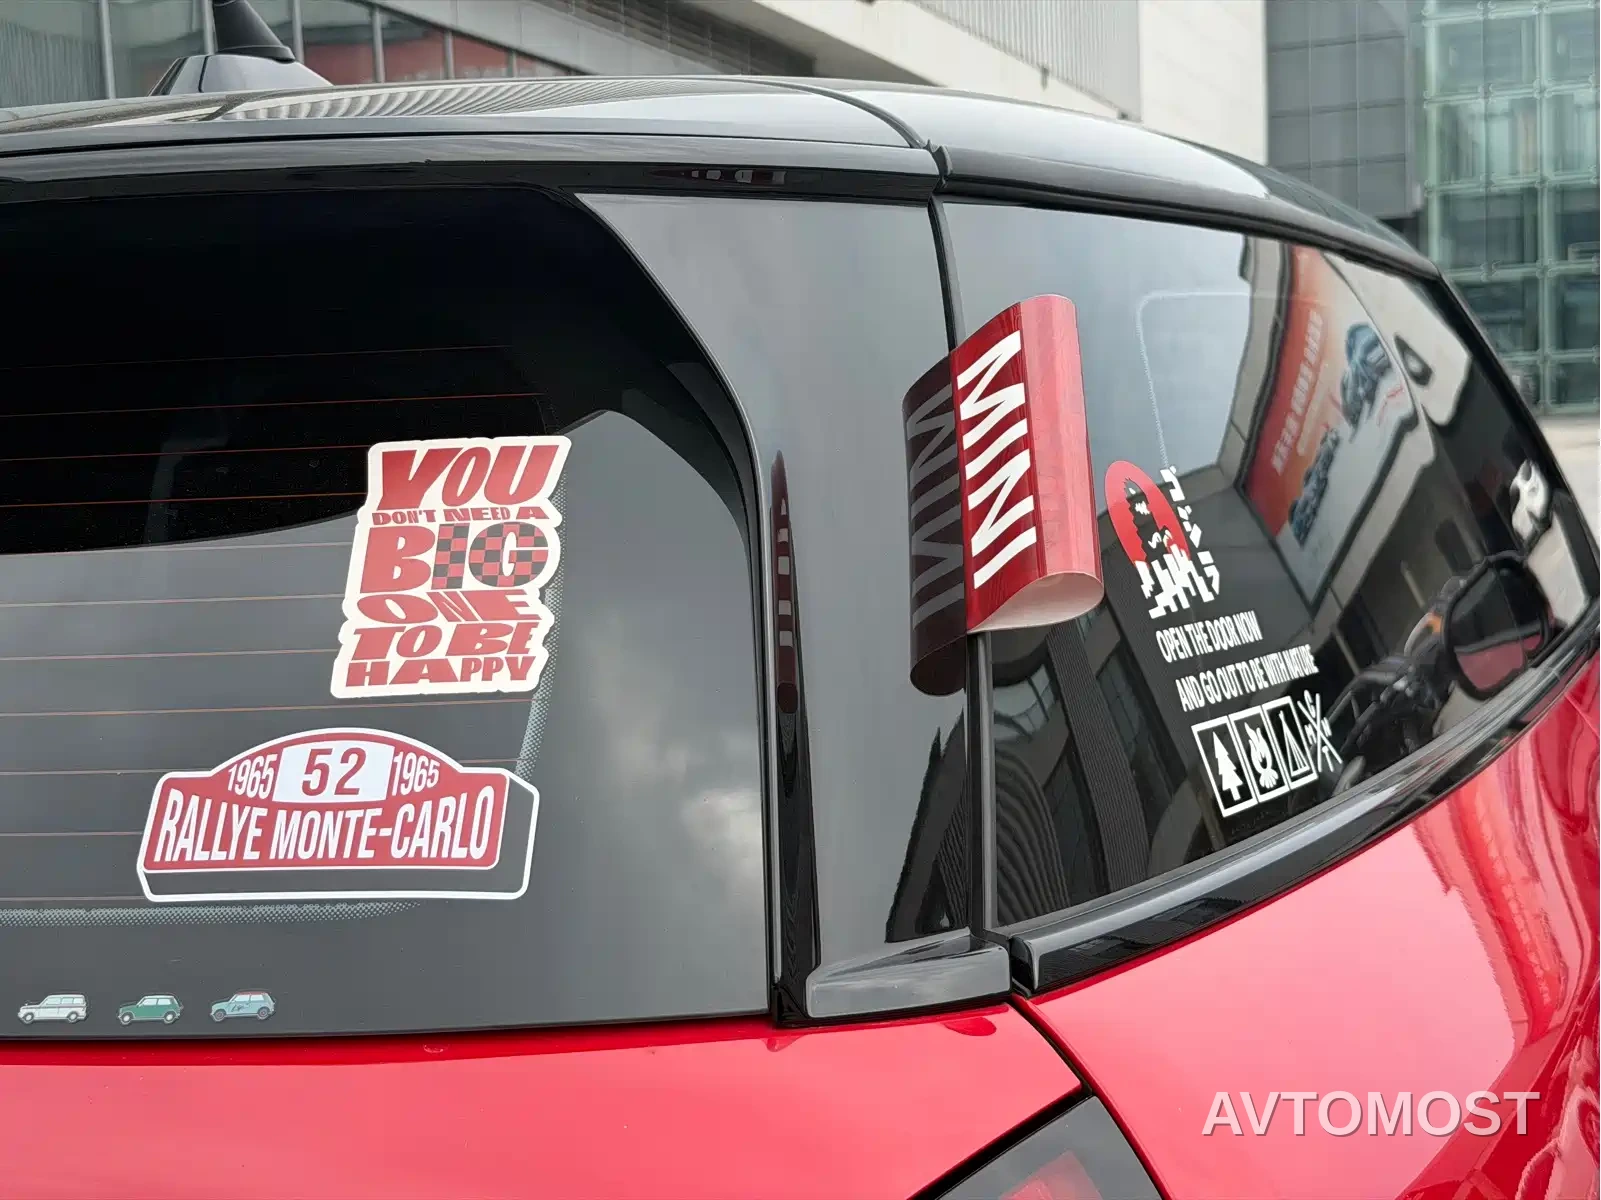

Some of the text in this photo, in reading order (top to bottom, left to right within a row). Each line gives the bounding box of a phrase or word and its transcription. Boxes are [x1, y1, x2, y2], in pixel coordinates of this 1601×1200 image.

[377, 445, 560, 510] YOU
[957, 330, 1037, 590] MINI
[372, 506, 550, 525] DON'T NEED A
[360, 521, 549, 593] BIG
[356, 589, 542, 624] ONE
[351, 622, 540, 661] TO BE
[1156, 610, 1263, 663] OPEN THE DOOR NOW
[345, 656, 537, 687] HAPPY
[1176, 644, 1319, 712] AND GO OUT TO BE WITH NATURE
[228, 747, 440, 800] 1965 52 1965
[153, 785, 494, 862] RALLYE MONTE-CARLO
